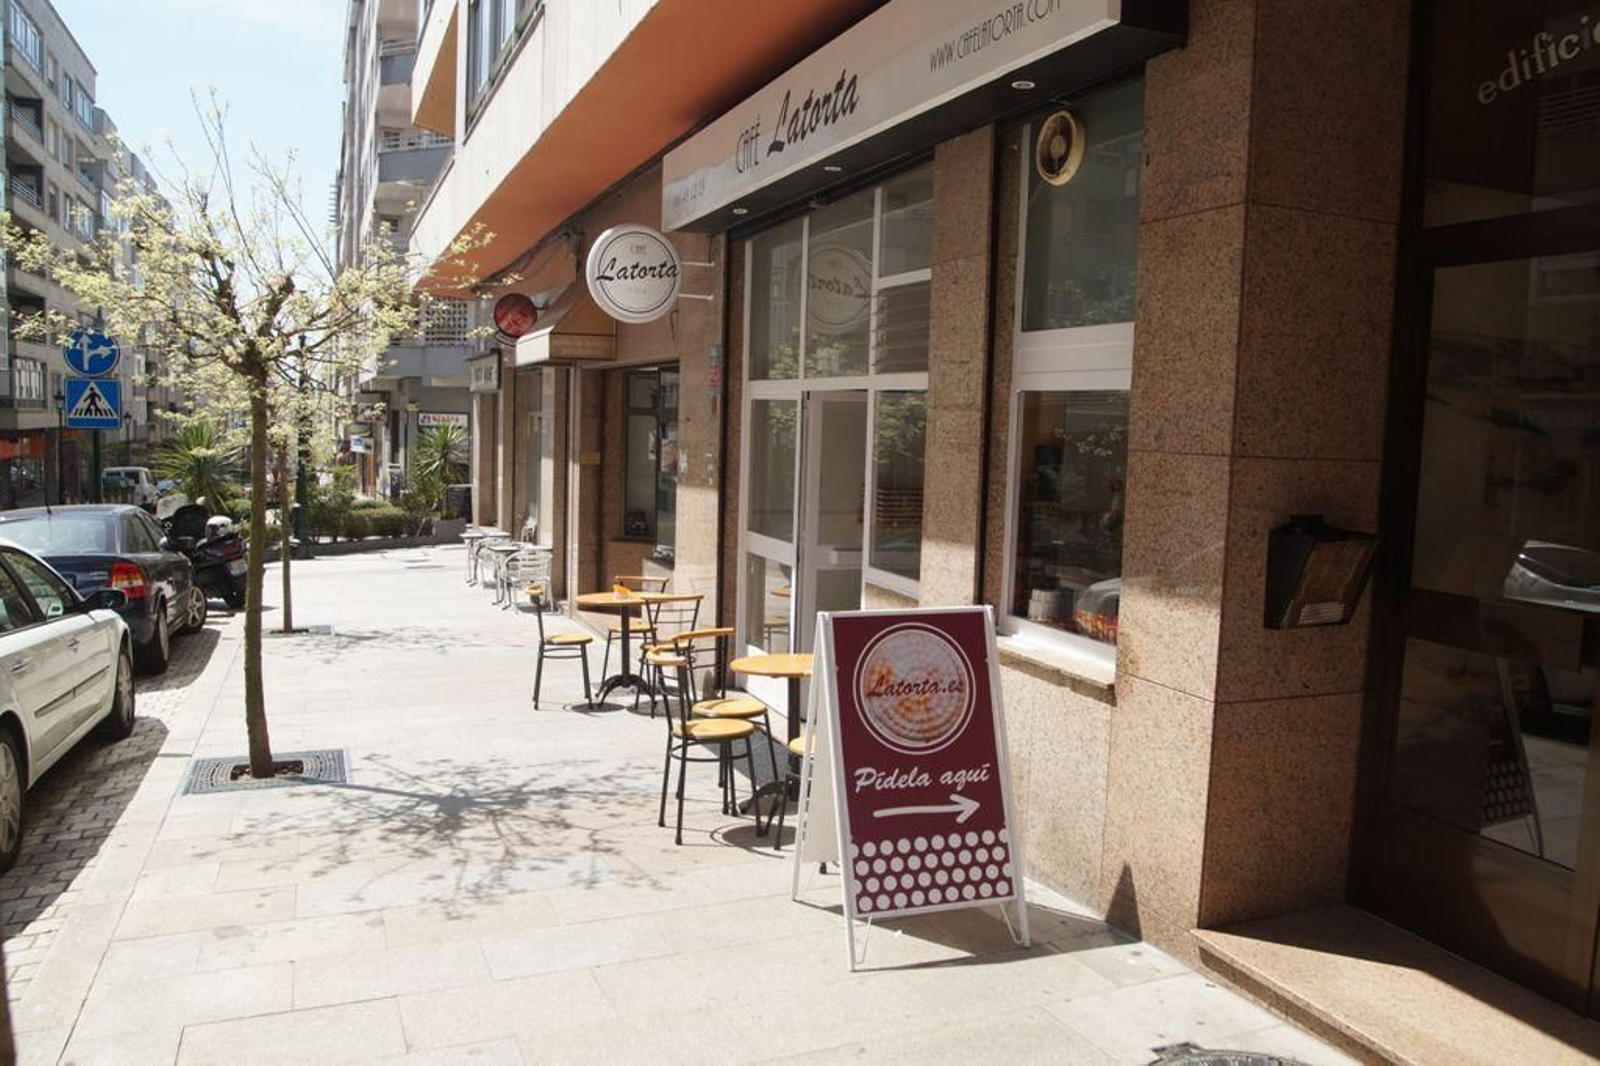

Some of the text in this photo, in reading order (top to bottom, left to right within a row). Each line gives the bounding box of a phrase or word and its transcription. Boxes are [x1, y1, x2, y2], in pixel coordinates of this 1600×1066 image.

[767, 68, 860, 158] Latorta
[596, 256, 680, 282] Latorta
[866, 674, 965, 698] Latorta.es
[854, 763, 991, 794] Pídela aquí
